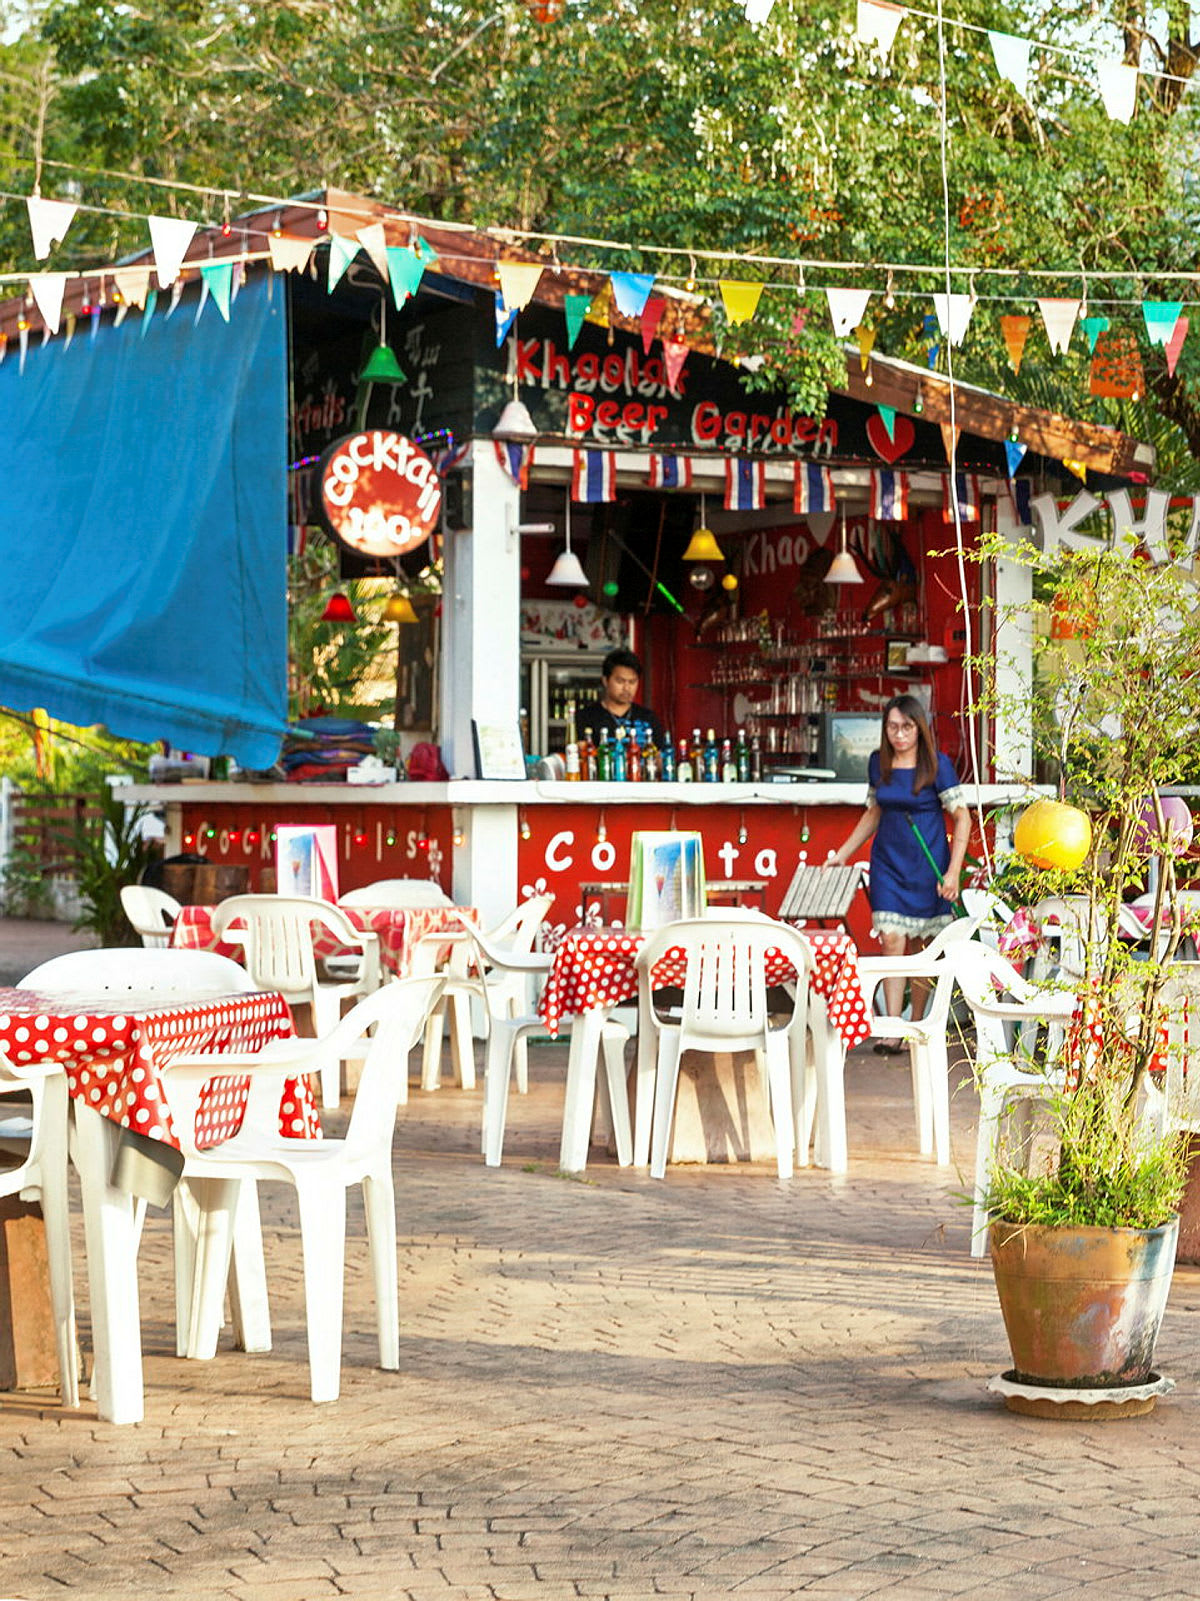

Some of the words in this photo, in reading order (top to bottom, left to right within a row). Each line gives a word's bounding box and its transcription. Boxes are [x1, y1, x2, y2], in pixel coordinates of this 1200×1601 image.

[566, 391, 668, 443] Beer
[692, 400, 838, 457] Garden
[743, 531, 809, 577] Khao
[196, 822, 418, 862] Cockils
